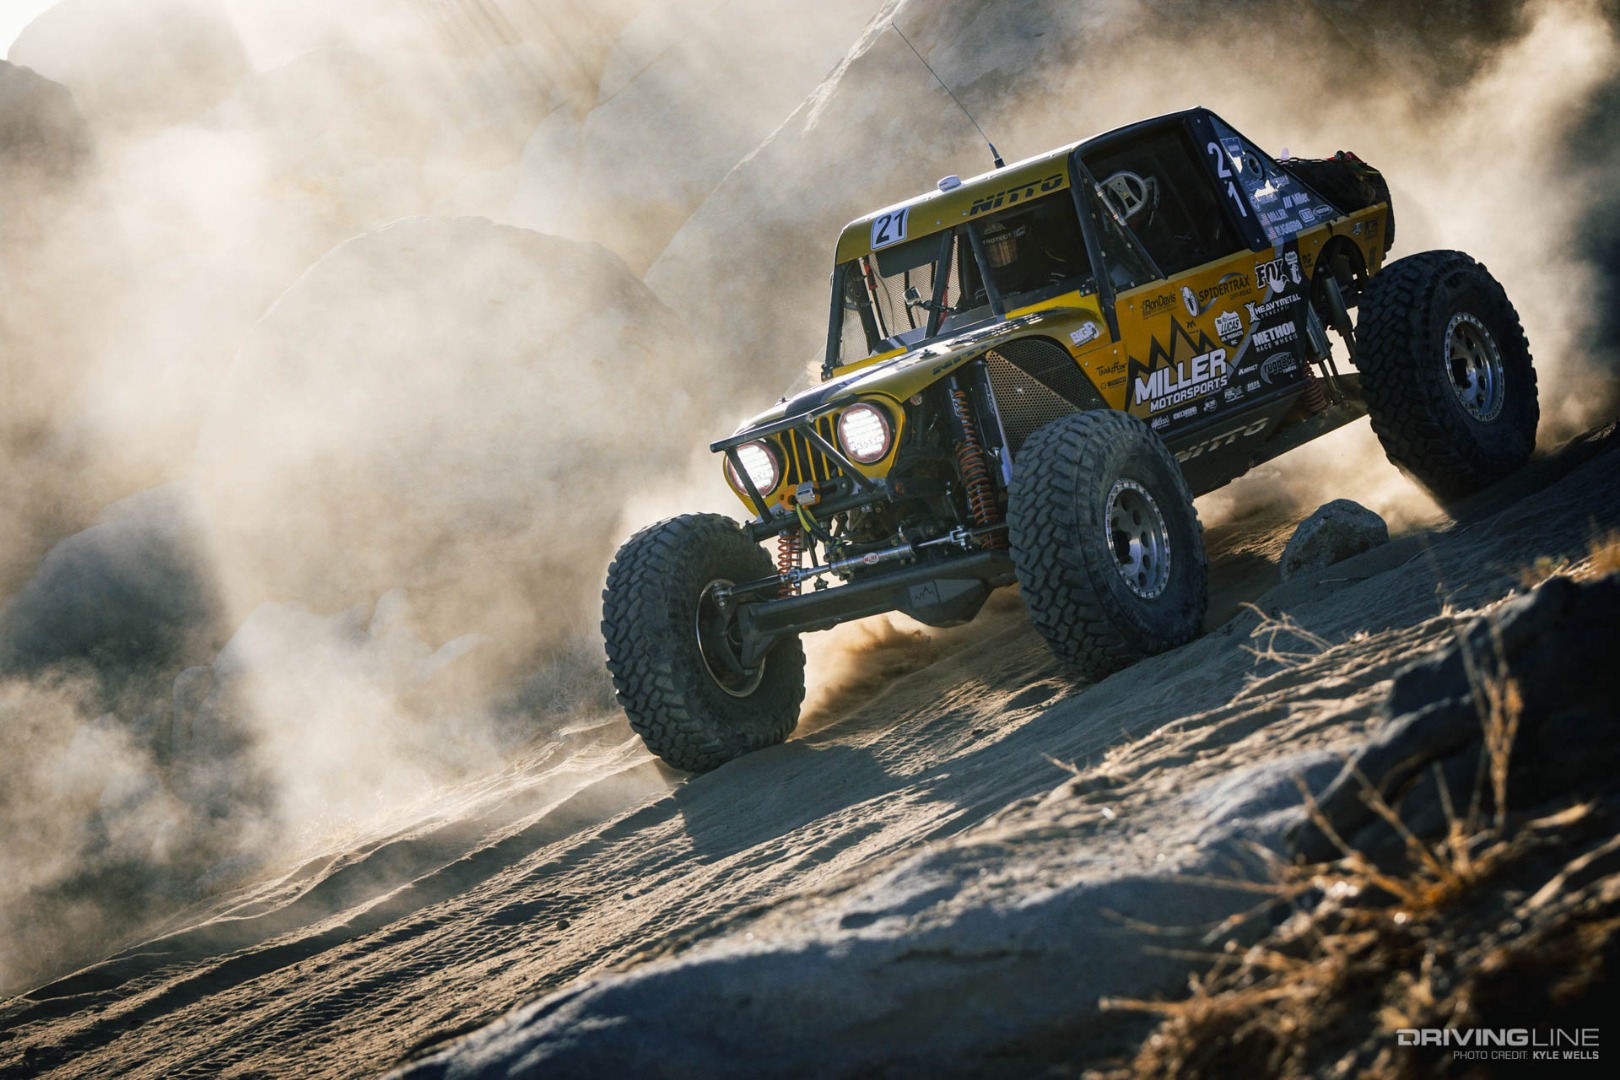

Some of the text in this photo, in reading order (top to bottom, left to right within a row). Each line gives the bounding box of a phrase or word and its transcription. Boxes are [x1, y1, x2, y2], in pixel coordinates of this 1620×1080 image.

[969, 174, 1063, 216] NITTO
[875, 208, 906, 245] 21
[1198, 275, 1250, 302] SPIDERTRAX
[1255, 258, 1287, 291] FOX
[1220, 318, 1240, 334] LUCAS
[1252, 321, 1296, 347] METHOD
[1256, 343, 1273, 353] RACE
[1134, 347, 1227, 405] MILLER
[1150, 375, 1228, 413] MOTORSPORTS
